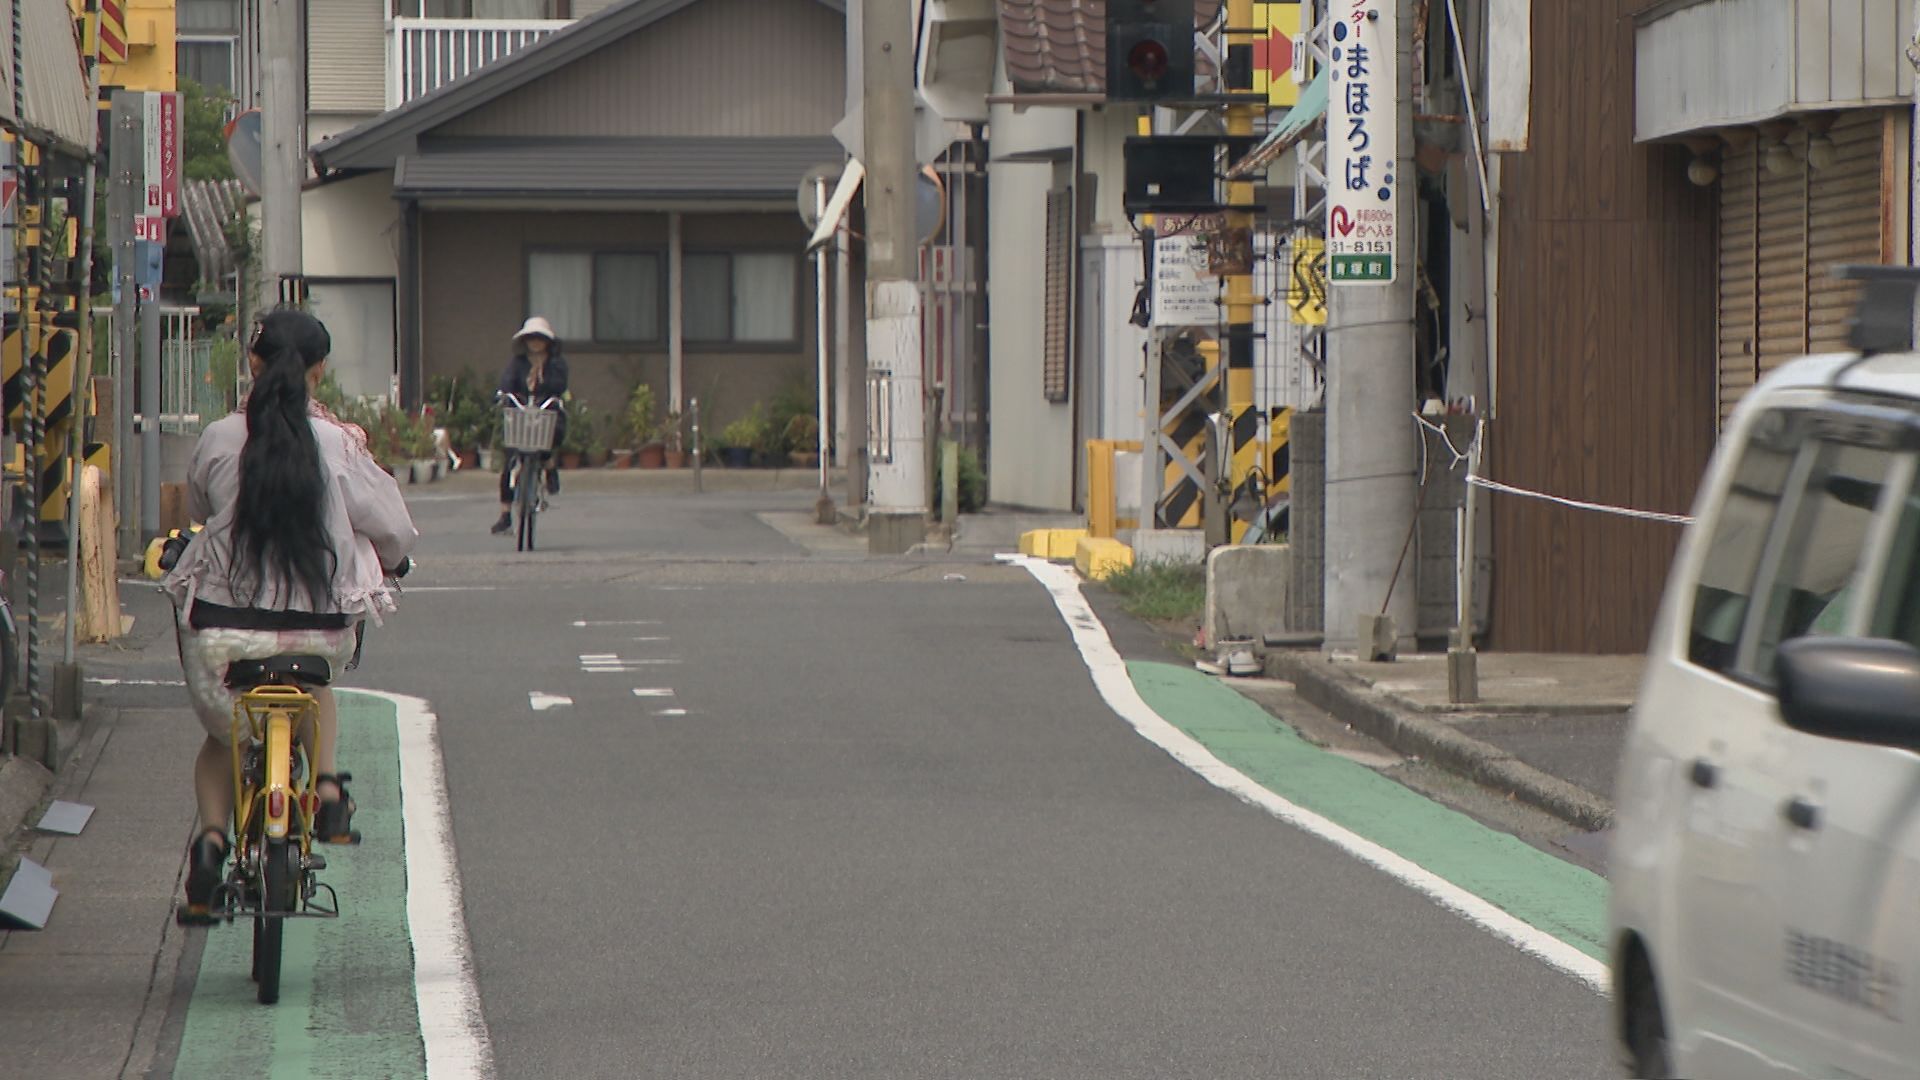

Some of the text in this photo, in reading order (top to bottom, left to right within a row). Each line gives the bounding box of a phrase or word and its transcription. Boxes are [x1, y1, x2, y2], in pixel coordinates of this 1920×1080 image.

[1346, 43, 1371, 190] まほろば
[1356, 223, 1393, 238] 西へ入る
[1331, 241, 1392, 253] 31-8151
